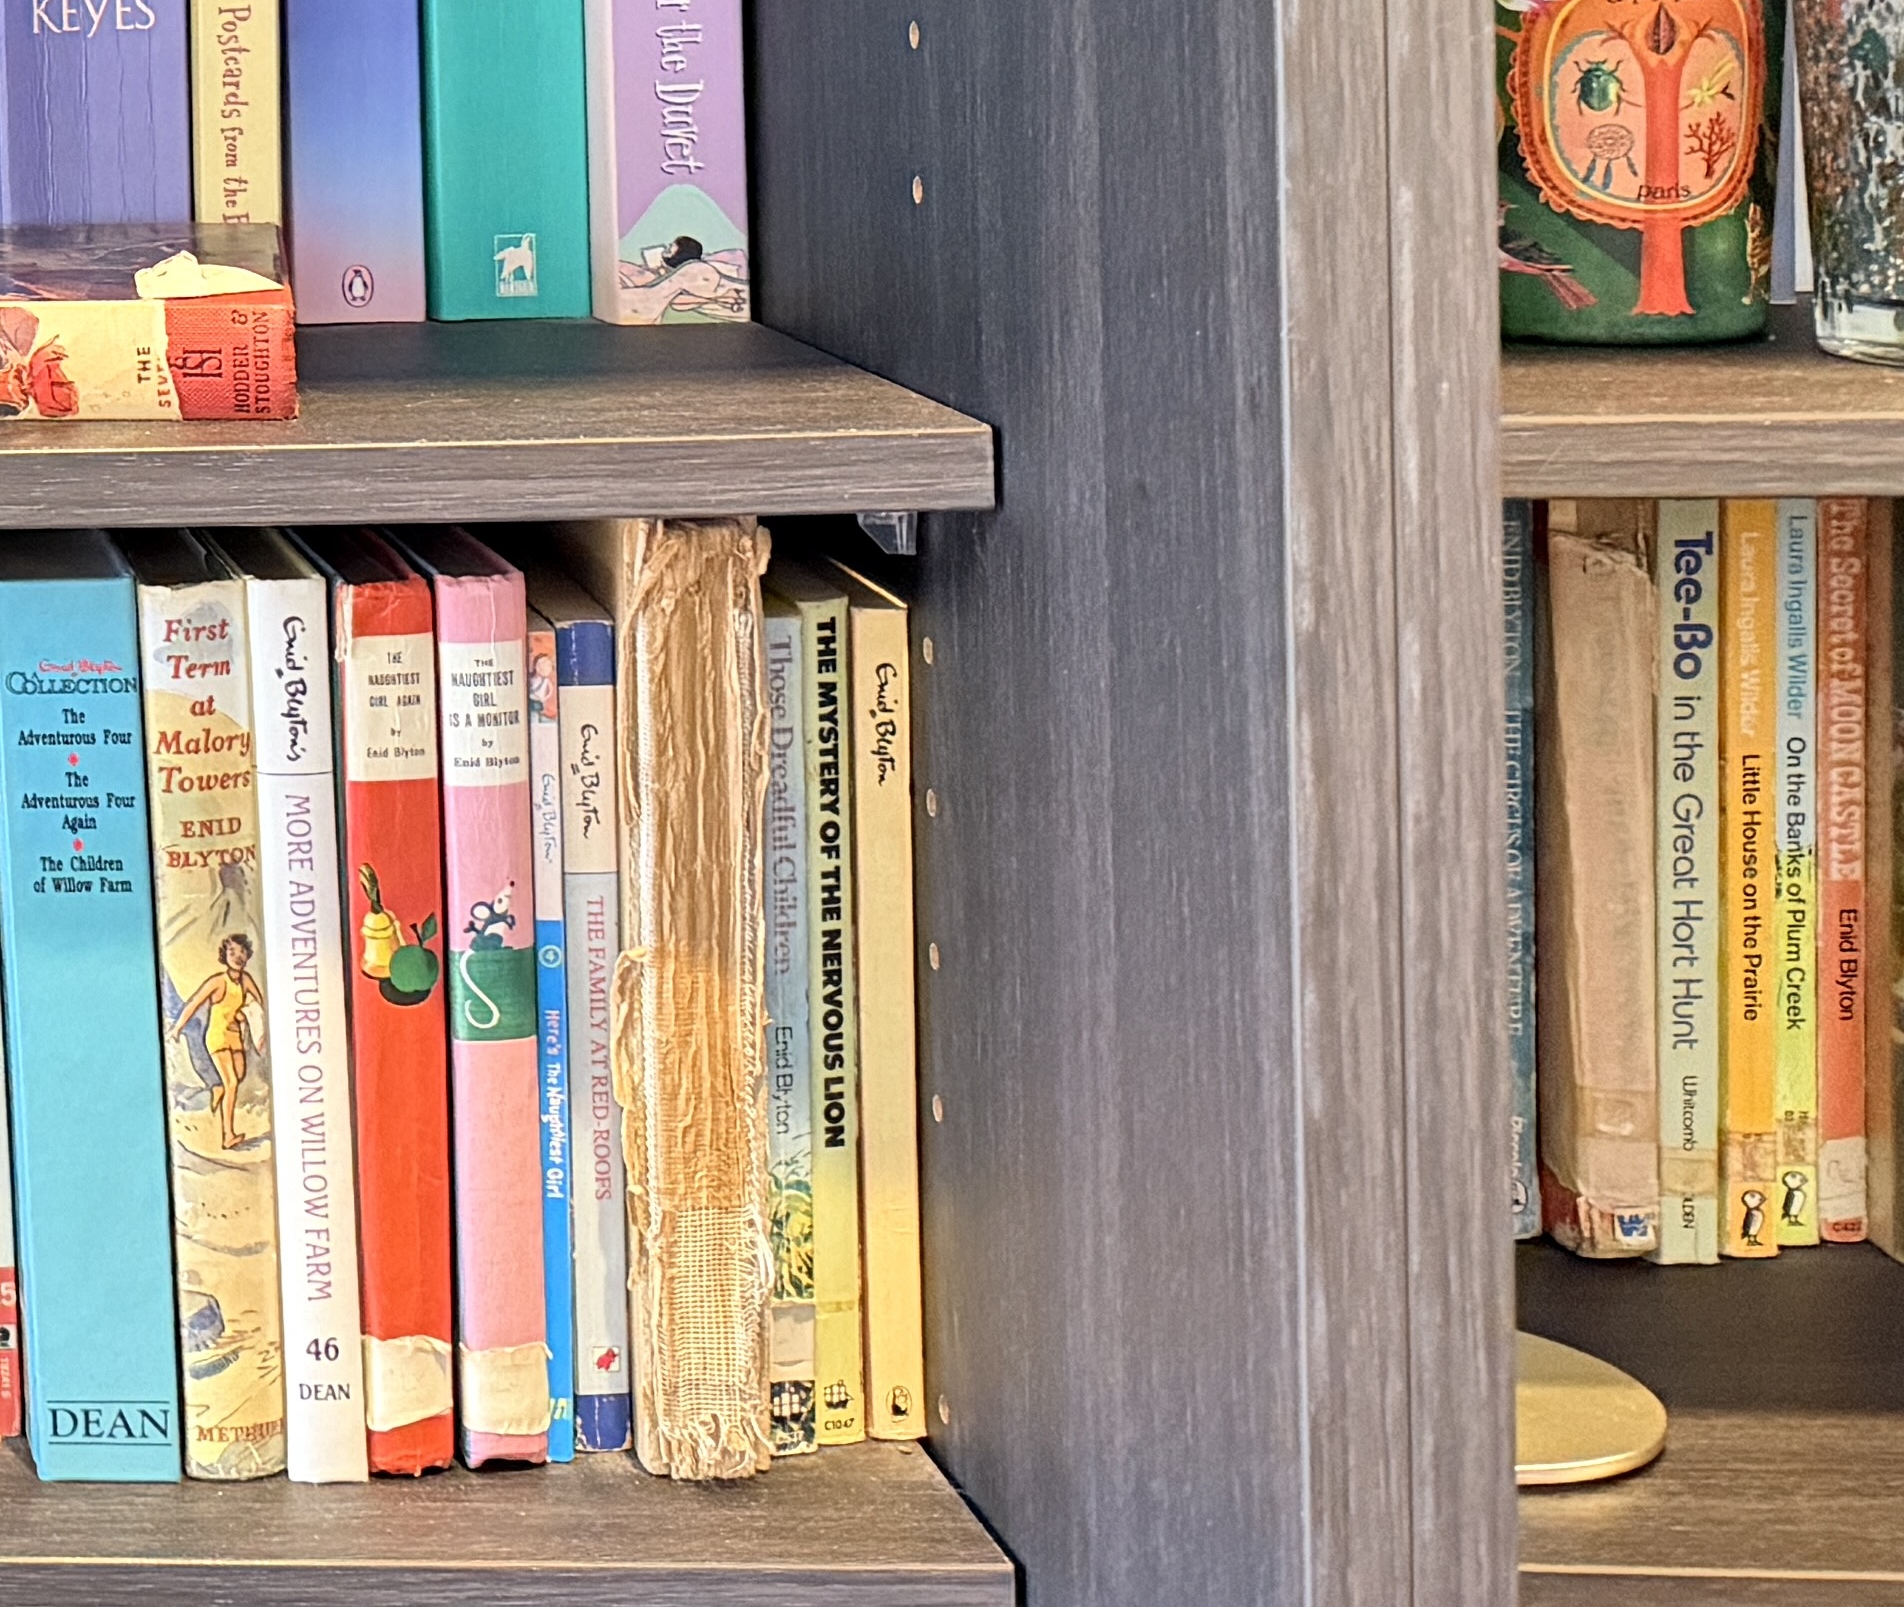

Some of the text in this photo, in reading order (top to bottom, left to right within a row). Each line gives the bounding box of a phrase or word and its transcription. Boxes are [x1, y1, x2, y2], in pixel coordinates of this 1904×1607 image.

[656, 21, 703, 72] the
[654, 80, 704, 174] Duvet
[1637, 182, 1691, 202] paris
[164, 619, 229, 642] First
[168, 655, 231, 679] Term
[190, 696, 216, 716] at
[153, 729, 251, 756] Malory
[159, 766, 250, 793] Towers
[1673, 531, 1713, 1051] Tee-Bo in the Great Hort Hunt
[180, 818, 242, 839] ENID
[164, 845, 256, 869] BLYTON
[818, 617, 845, 1148] THE MYSTERY OF THE NERVOUS LION
[1741, 754, 1762, 1022] Little House on the Prairie
[306, 1337, 339, 1361] 46
[299, 1383, 351, 1402] DEAN
[48, 1408, 170, 1439] DEAN
